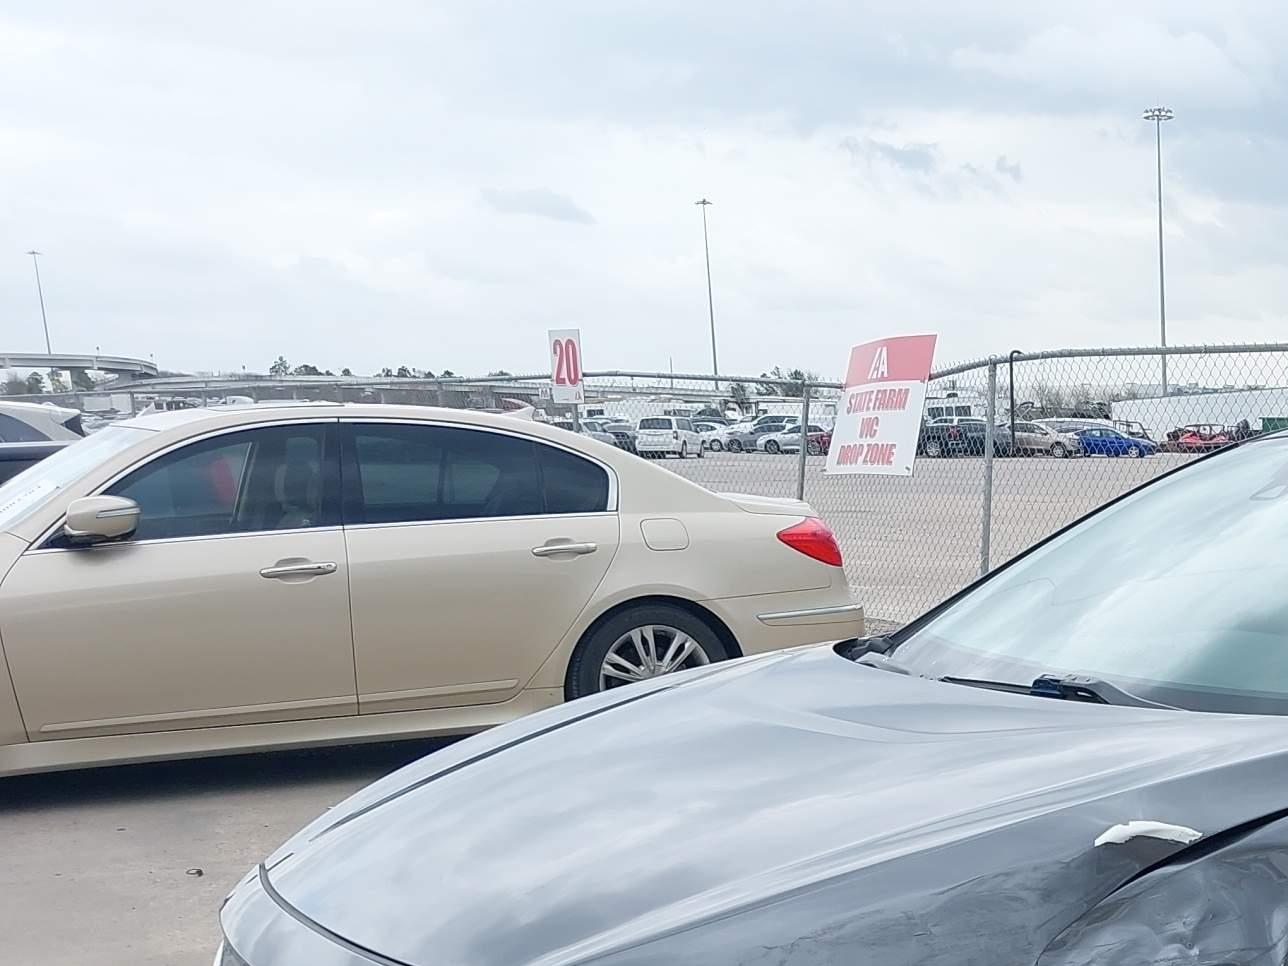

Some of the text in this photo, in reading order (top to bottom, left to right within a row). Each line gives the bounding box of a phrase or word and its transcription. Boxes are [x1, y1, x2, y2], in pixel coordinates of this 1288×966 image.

[553, 338, 579, 386] 20
[846, 388, 910, 415] STATE FARM
[858, 416, 880, 439] VIC
[836, 443, 897, 466] DROP ZONE
